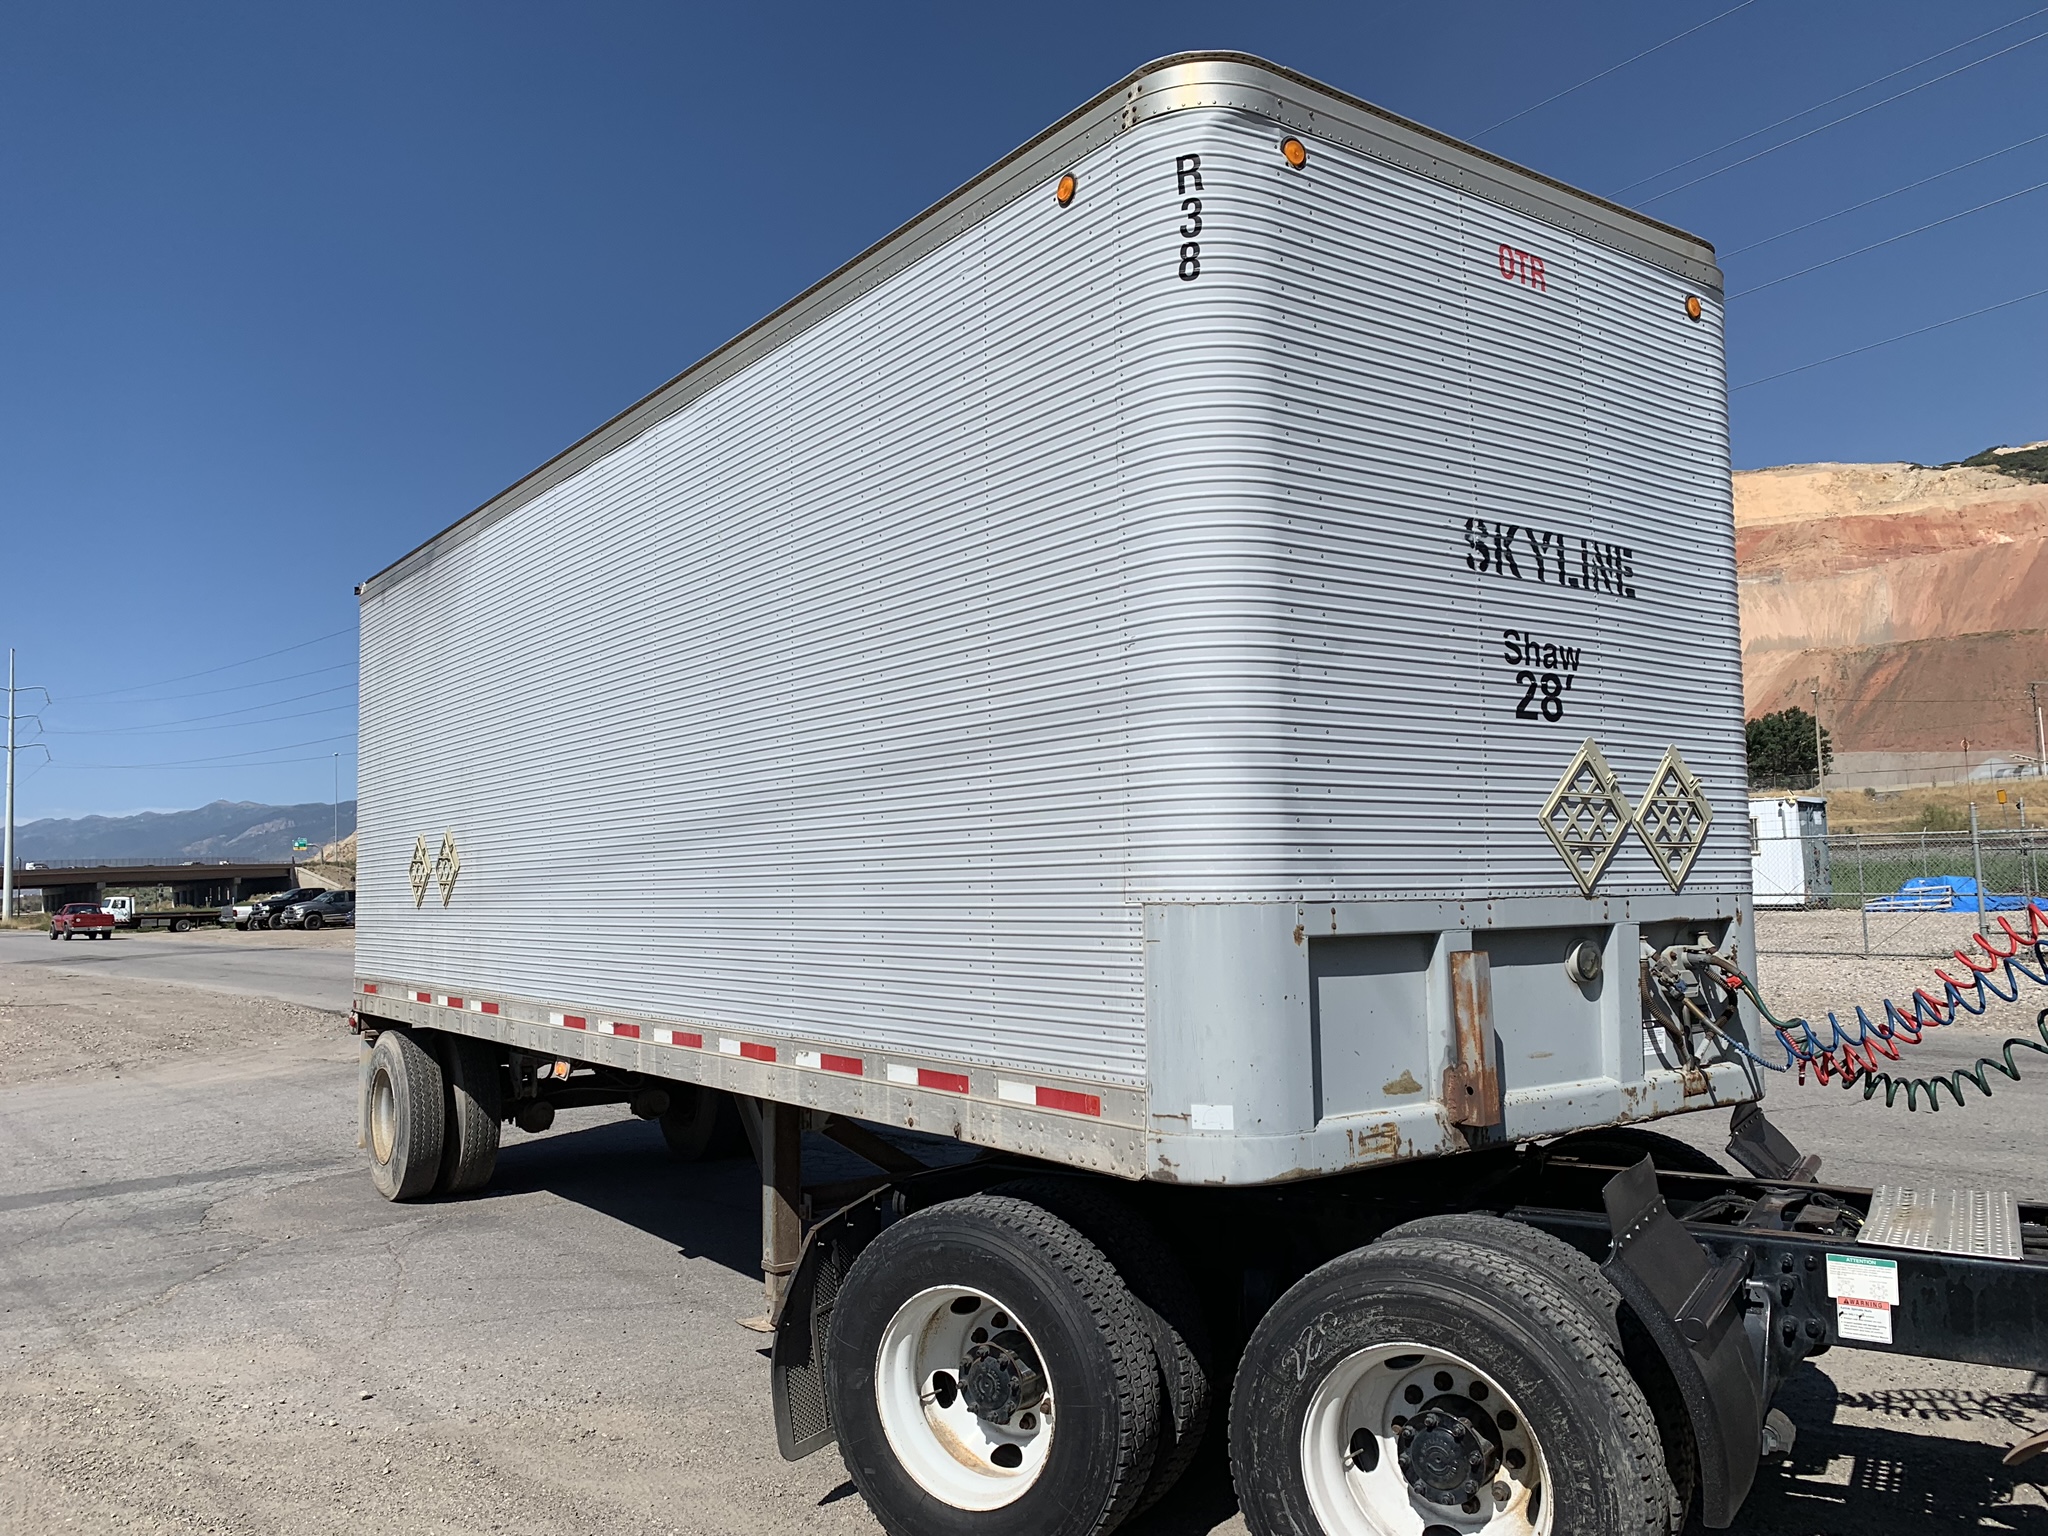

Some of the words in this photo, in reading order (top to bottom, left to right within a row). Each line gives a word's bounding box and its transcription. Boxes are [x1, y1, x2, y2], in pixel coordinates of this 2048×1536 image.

[1498, 244, 1547, 292] OTR
[1464, 517, 1636, 598] SKYLINE
[1503, 629, 1581, 672] Shaw
[1845, 1257, 1877, 1265] ATTENTION
[1849, 1299, 1883, 1309] WARNING
